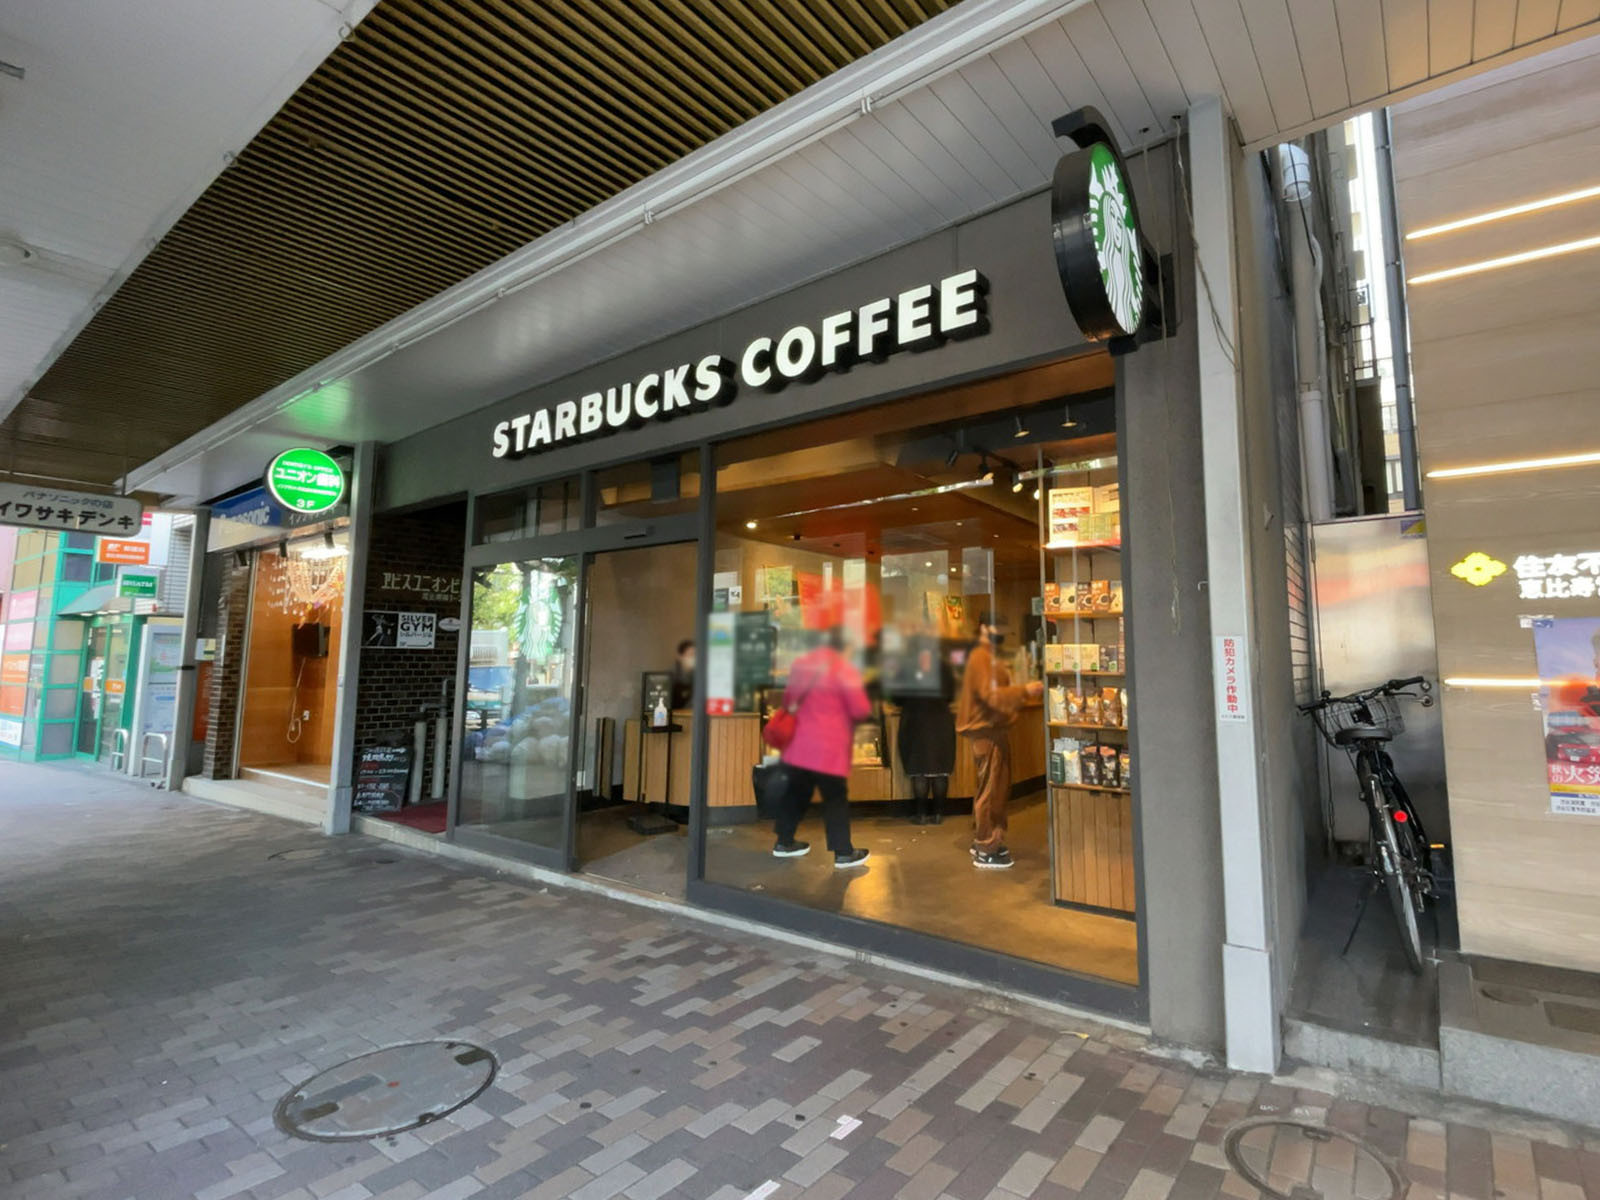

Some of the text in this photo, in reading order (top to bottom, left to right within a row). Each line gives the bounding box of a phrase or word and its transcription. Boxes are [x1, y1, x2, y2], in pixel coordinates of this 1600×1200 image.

[492, 269, 977, 459] STARBUCKS COFFEE
[0, 501, 135, 530] イワサキデンキ
[1518, 576, 1600, 599] 恵比寿
[400, 621, 434, 633] GYM
[401, 614, 434, 622] SILVER
[1223, 638, 1239, 713] 防犯カメラ作動中
